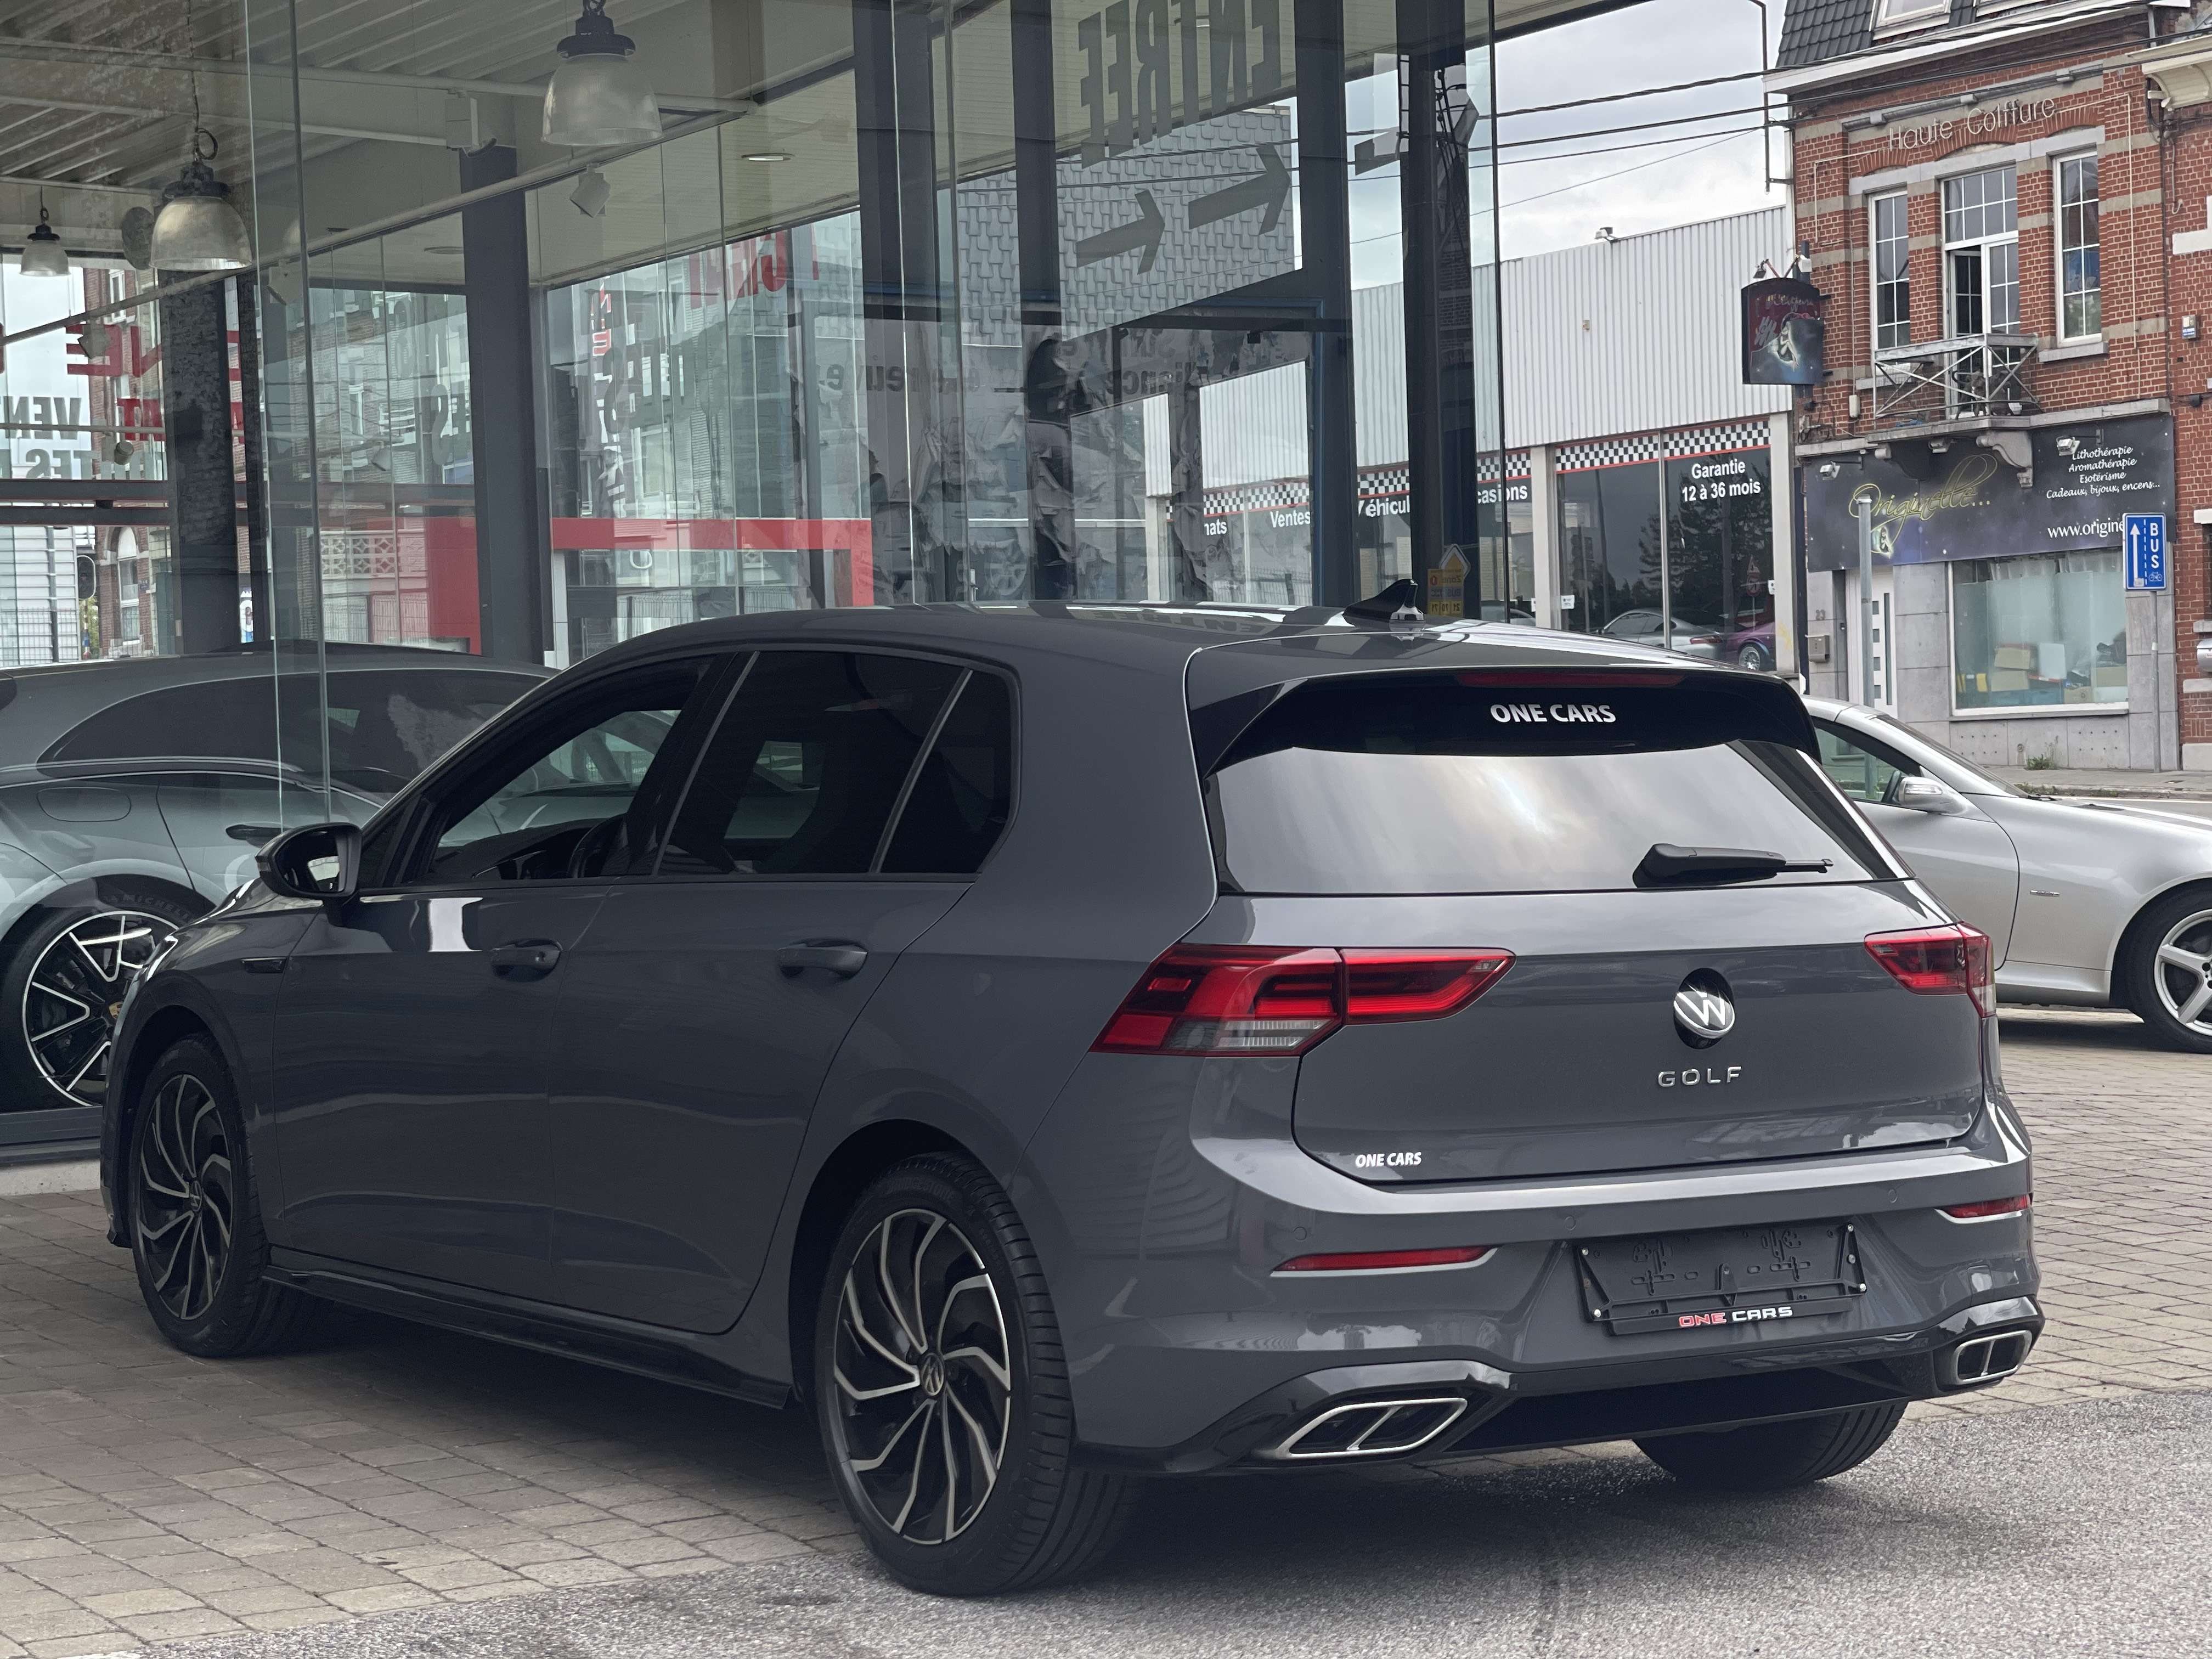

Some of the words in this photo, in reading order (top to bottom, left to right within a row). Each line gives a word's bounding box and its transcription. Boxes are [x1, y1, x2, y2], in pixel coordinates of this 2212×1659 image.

[1889, 117, 1953, 152] Haute
[1967, 98, 2055, 134] Coiffure
[2072, 445, 2134, 460] Lithothérapie
[1691, 458, 1746, 479] Garantie
[2068, 458, 2138, 472] Aromathérapie
[2079, 471, 2127, 483] Esotérisme
[1681, 485, 1697, 502] 12
[1699, 484, 1708, 500] à
[1710, 482, 1726, 499] 36
[1729, 478, 1761, 496] mois
[2046, 487, 2087, 499] Cadeaux,
[2090, 485, 2120, 496] bijoux,
[1269, 509, 1311, 528] Ventes
[2047, 517, 2124, 538] www.origine
[2149, 522, 2160, 569] BUS
[1490, 704, 1548, 723] ONE
[1549, 704, 1616, 723] CARS
[1658, 1066, 1742, 1087] GOLF
[1355, 1153, 1385, 1168] ONE
[1386, 1152, 1423, 1166] CARS
[1679, 1312, 1727, 1328] ONE
[1731, 1306, 1793, 1322] CARS
